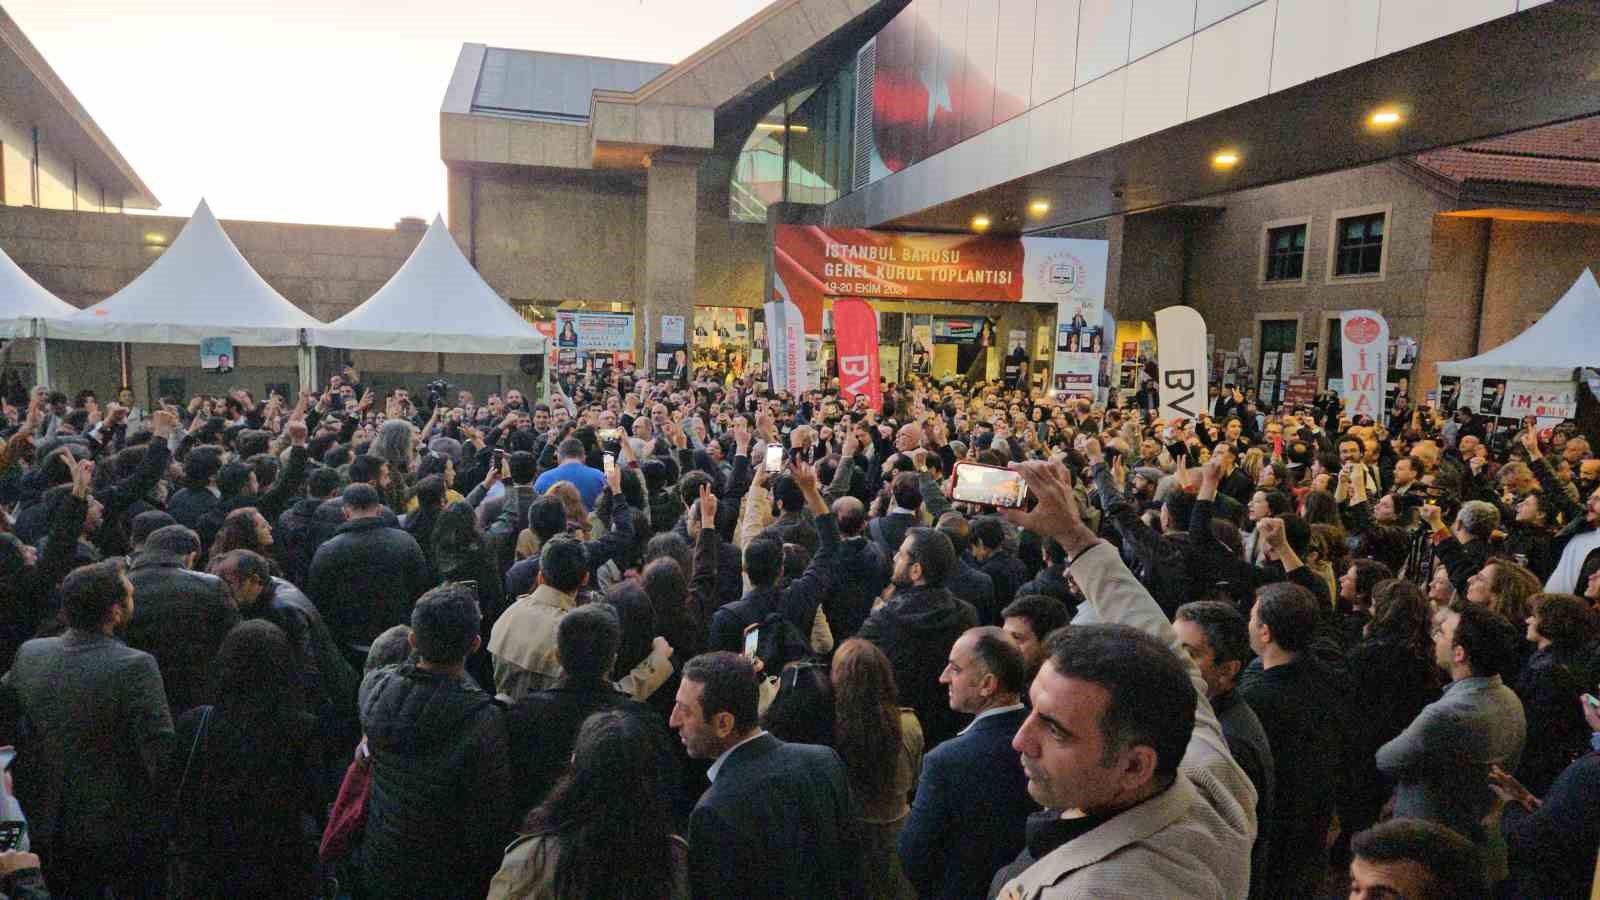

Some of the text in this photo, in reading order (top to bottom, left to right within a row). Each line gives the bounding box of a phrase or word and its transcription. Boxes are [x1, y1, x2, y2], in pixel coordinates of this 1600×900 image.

[825, 241, 960, 264] İSTANBUL BAROSU
[824, 262, 1012, 285] GENEL KURUL TOPLANTISI
[825, 281, 908, 296] 19-20 EKİM 2024
[1165, 369, 1196, 418] BV
